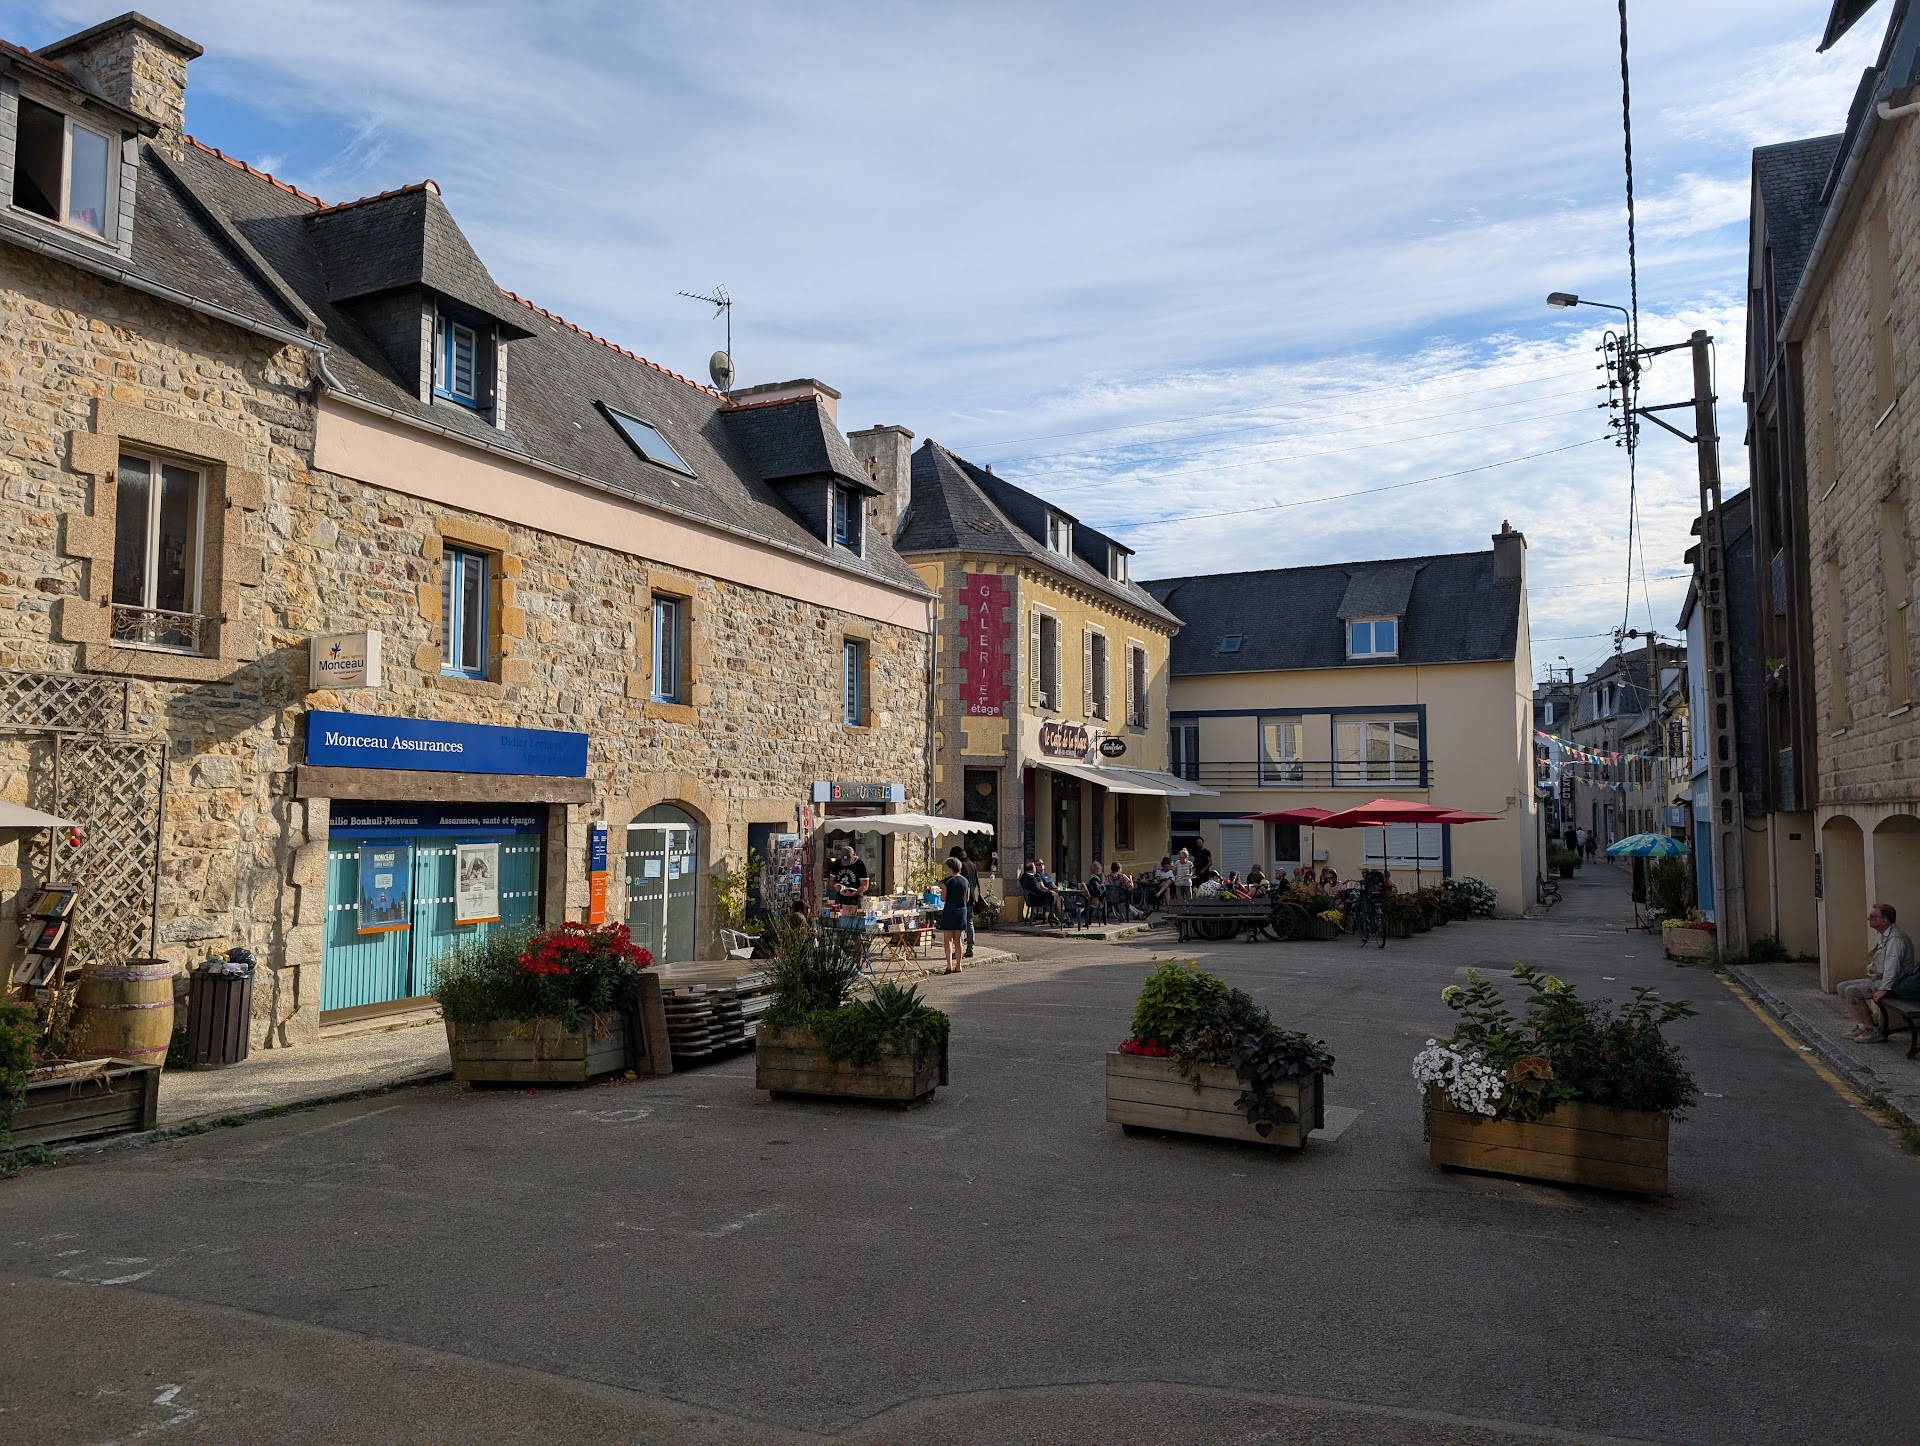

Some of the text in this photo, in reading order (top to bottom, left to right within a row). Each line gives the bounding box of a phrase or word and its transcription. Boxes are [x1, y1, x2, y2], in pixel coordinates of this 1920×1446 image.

[980, 585, 990, 694] GALERIE
[318, 659, 364, 672] Monceau
[971, 704, 1000, 716] étage
[325, 731, 464, 753] Monceau Assurances
[501, 735, 527, 748] Didier
[833, 785, 891, 799] BOUNISTE
[1562, 776, 1571, 799] EXPO
[439, 816, 536, 826] Assurances, santé et épargne
